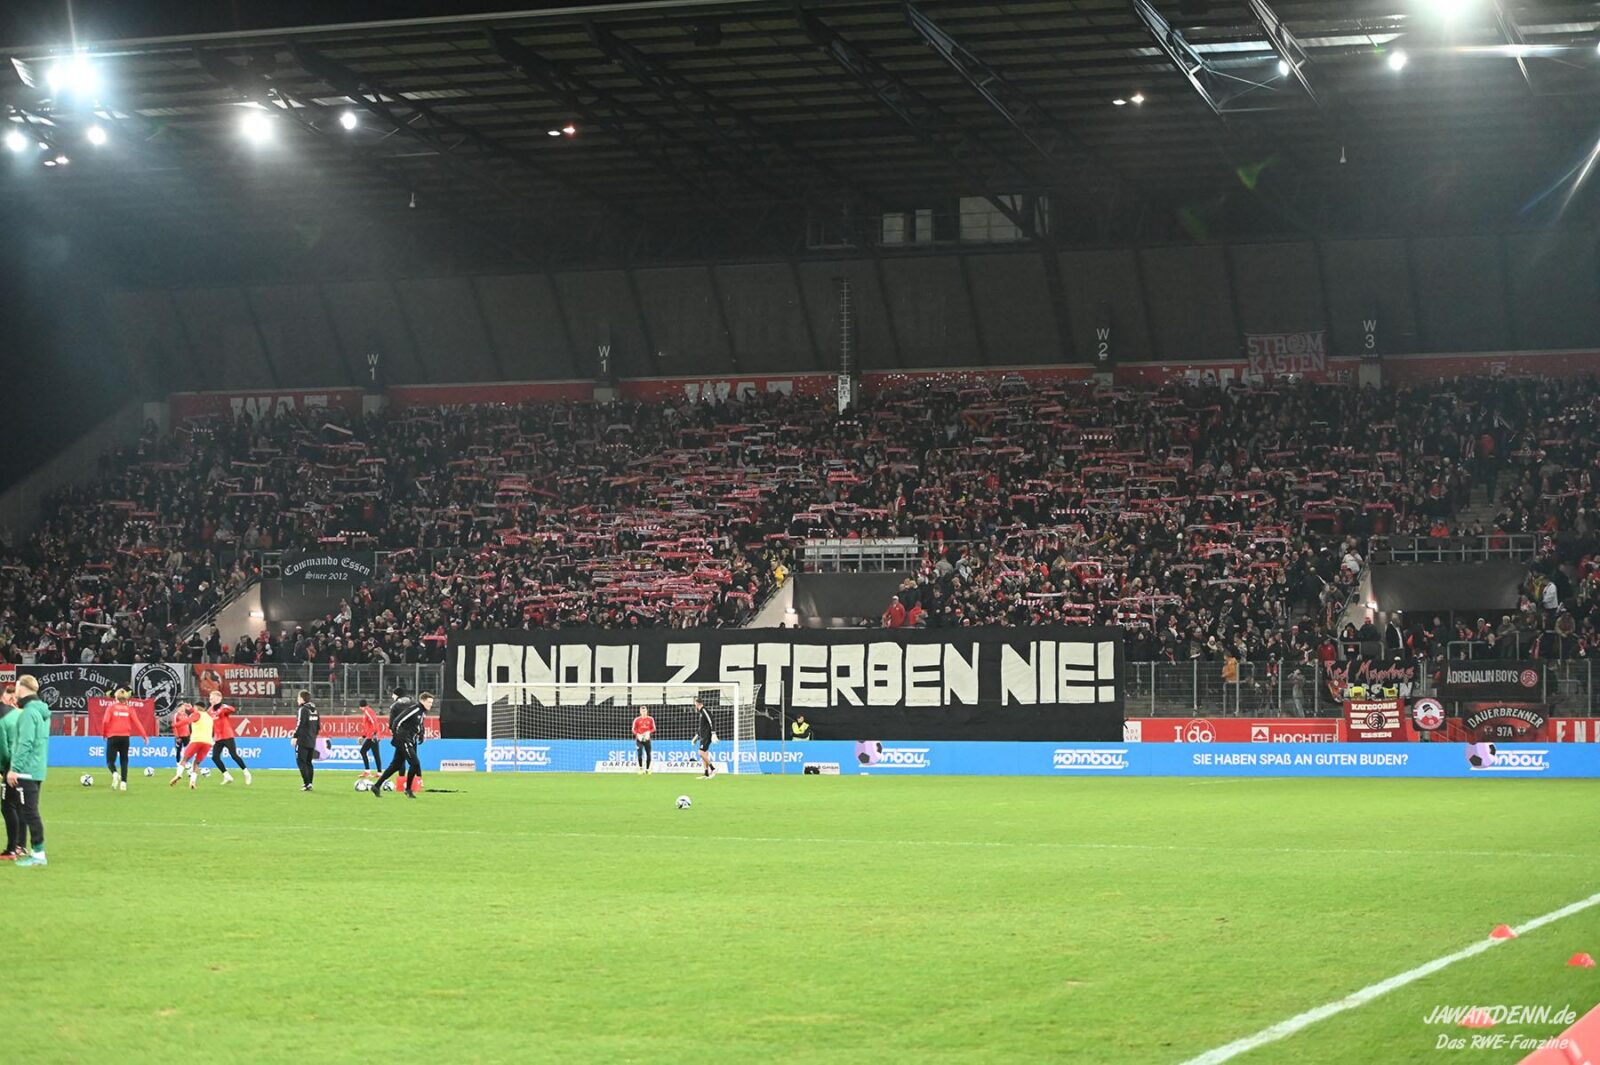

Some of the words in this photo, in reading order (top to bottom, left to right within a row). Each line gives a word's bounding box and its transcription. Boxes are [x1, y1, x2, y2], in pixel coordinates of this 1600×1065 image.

[1363, 320, 1376, 332] W
[1096, 328, 1110, 341] W
[1365, 334, 1375, 348] 3
[598, 346, 610, 356] W
[1098, 341, 1107, 355] 2
[367, 354, 379, 365] W
[601, 360, 607, 372] 1
[1250, 354, 1325, 375] KASTEN
[369, 367, 376, 380] 1
[284, 556, 338, 576] Commando
[341, 557, 370, 576] Essen
[328, 572, 348, 580] 2012
[38, 669, 74, 686] ssener
[719, 642, 980, 706] STERBEN
[1001, 641, 1115, 705] NIE!
[1446, 669, 1494, 684] ADRENALIN
[1496, 669, 1519, 683] BOYS
[229, 681, 276, 695] ESSEN
[1467, 707, 1544, 728] DAUERBRENNER
[1496, 726, 1513, 737] 97A
[88, 746, 104, 757] SIE
[222, 747, 261, 758] BDEN?
[608, 751, 626, 762] SIE
[759, 752, 803, 763] BUDEN?
[1193, 754, 1212, 765] SIE
[1214, 754, 1257, 765] HABEN
[1259, 754, 1291, 765] SPAß
[1294, 754, 1313, 765] AN
[1315, 754, 1357, 765] GUTEN
[1359, 754, 1408, 765] BUDEN?
